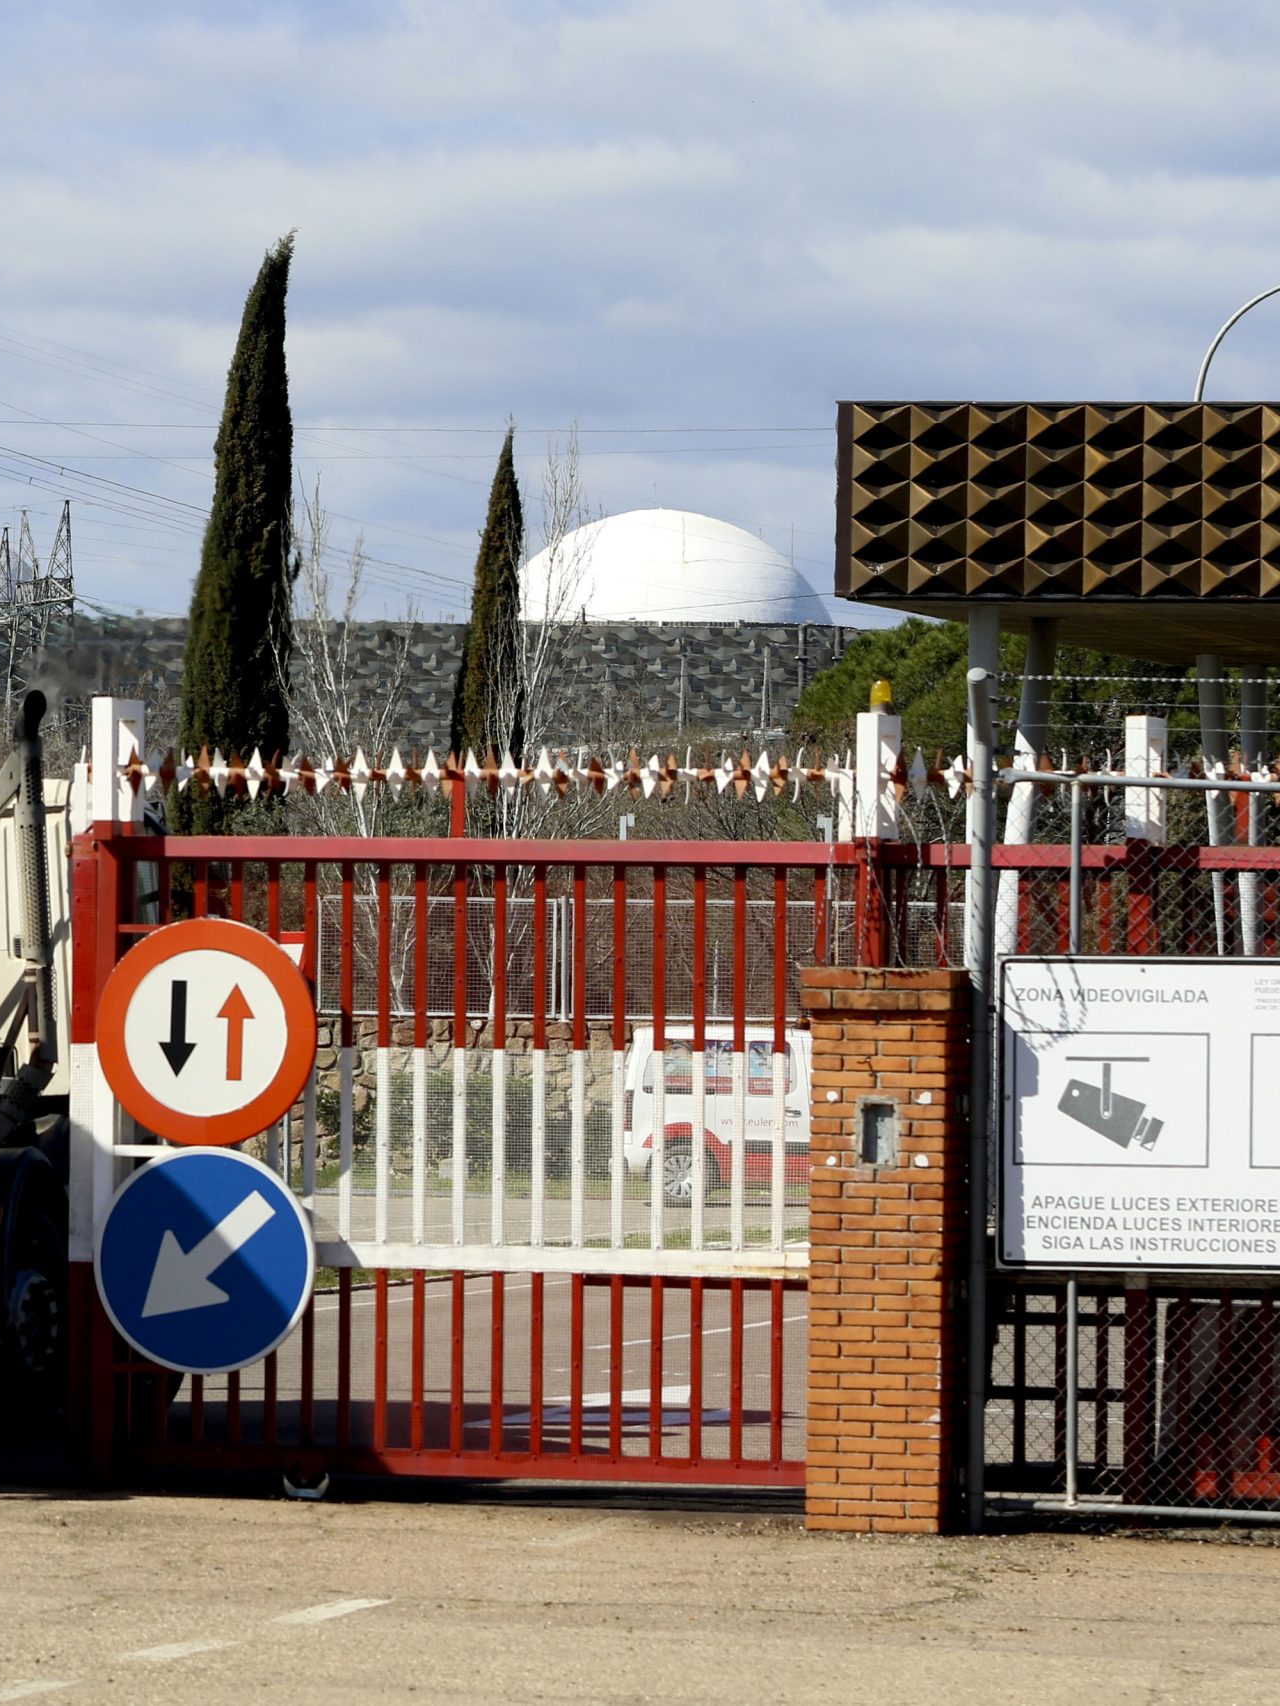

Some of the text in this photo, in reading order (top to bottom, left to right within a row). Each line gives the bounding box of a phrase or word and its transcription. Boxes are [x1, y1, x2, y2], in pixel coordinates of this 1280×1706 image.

[1016, 988, 1209, 1003] ZONA VIDEOVIGILADA
[1031, 1195, 1280, 1213] APAGUE LUCES EXTERIORE
[1026, 1215, 1118, 1230] ENCIENDA
[1123, 1217, 1182, 1231] LUCES
[1042, 1235, 1277, 1253] SIGA LAS INSTRUCCIONES
